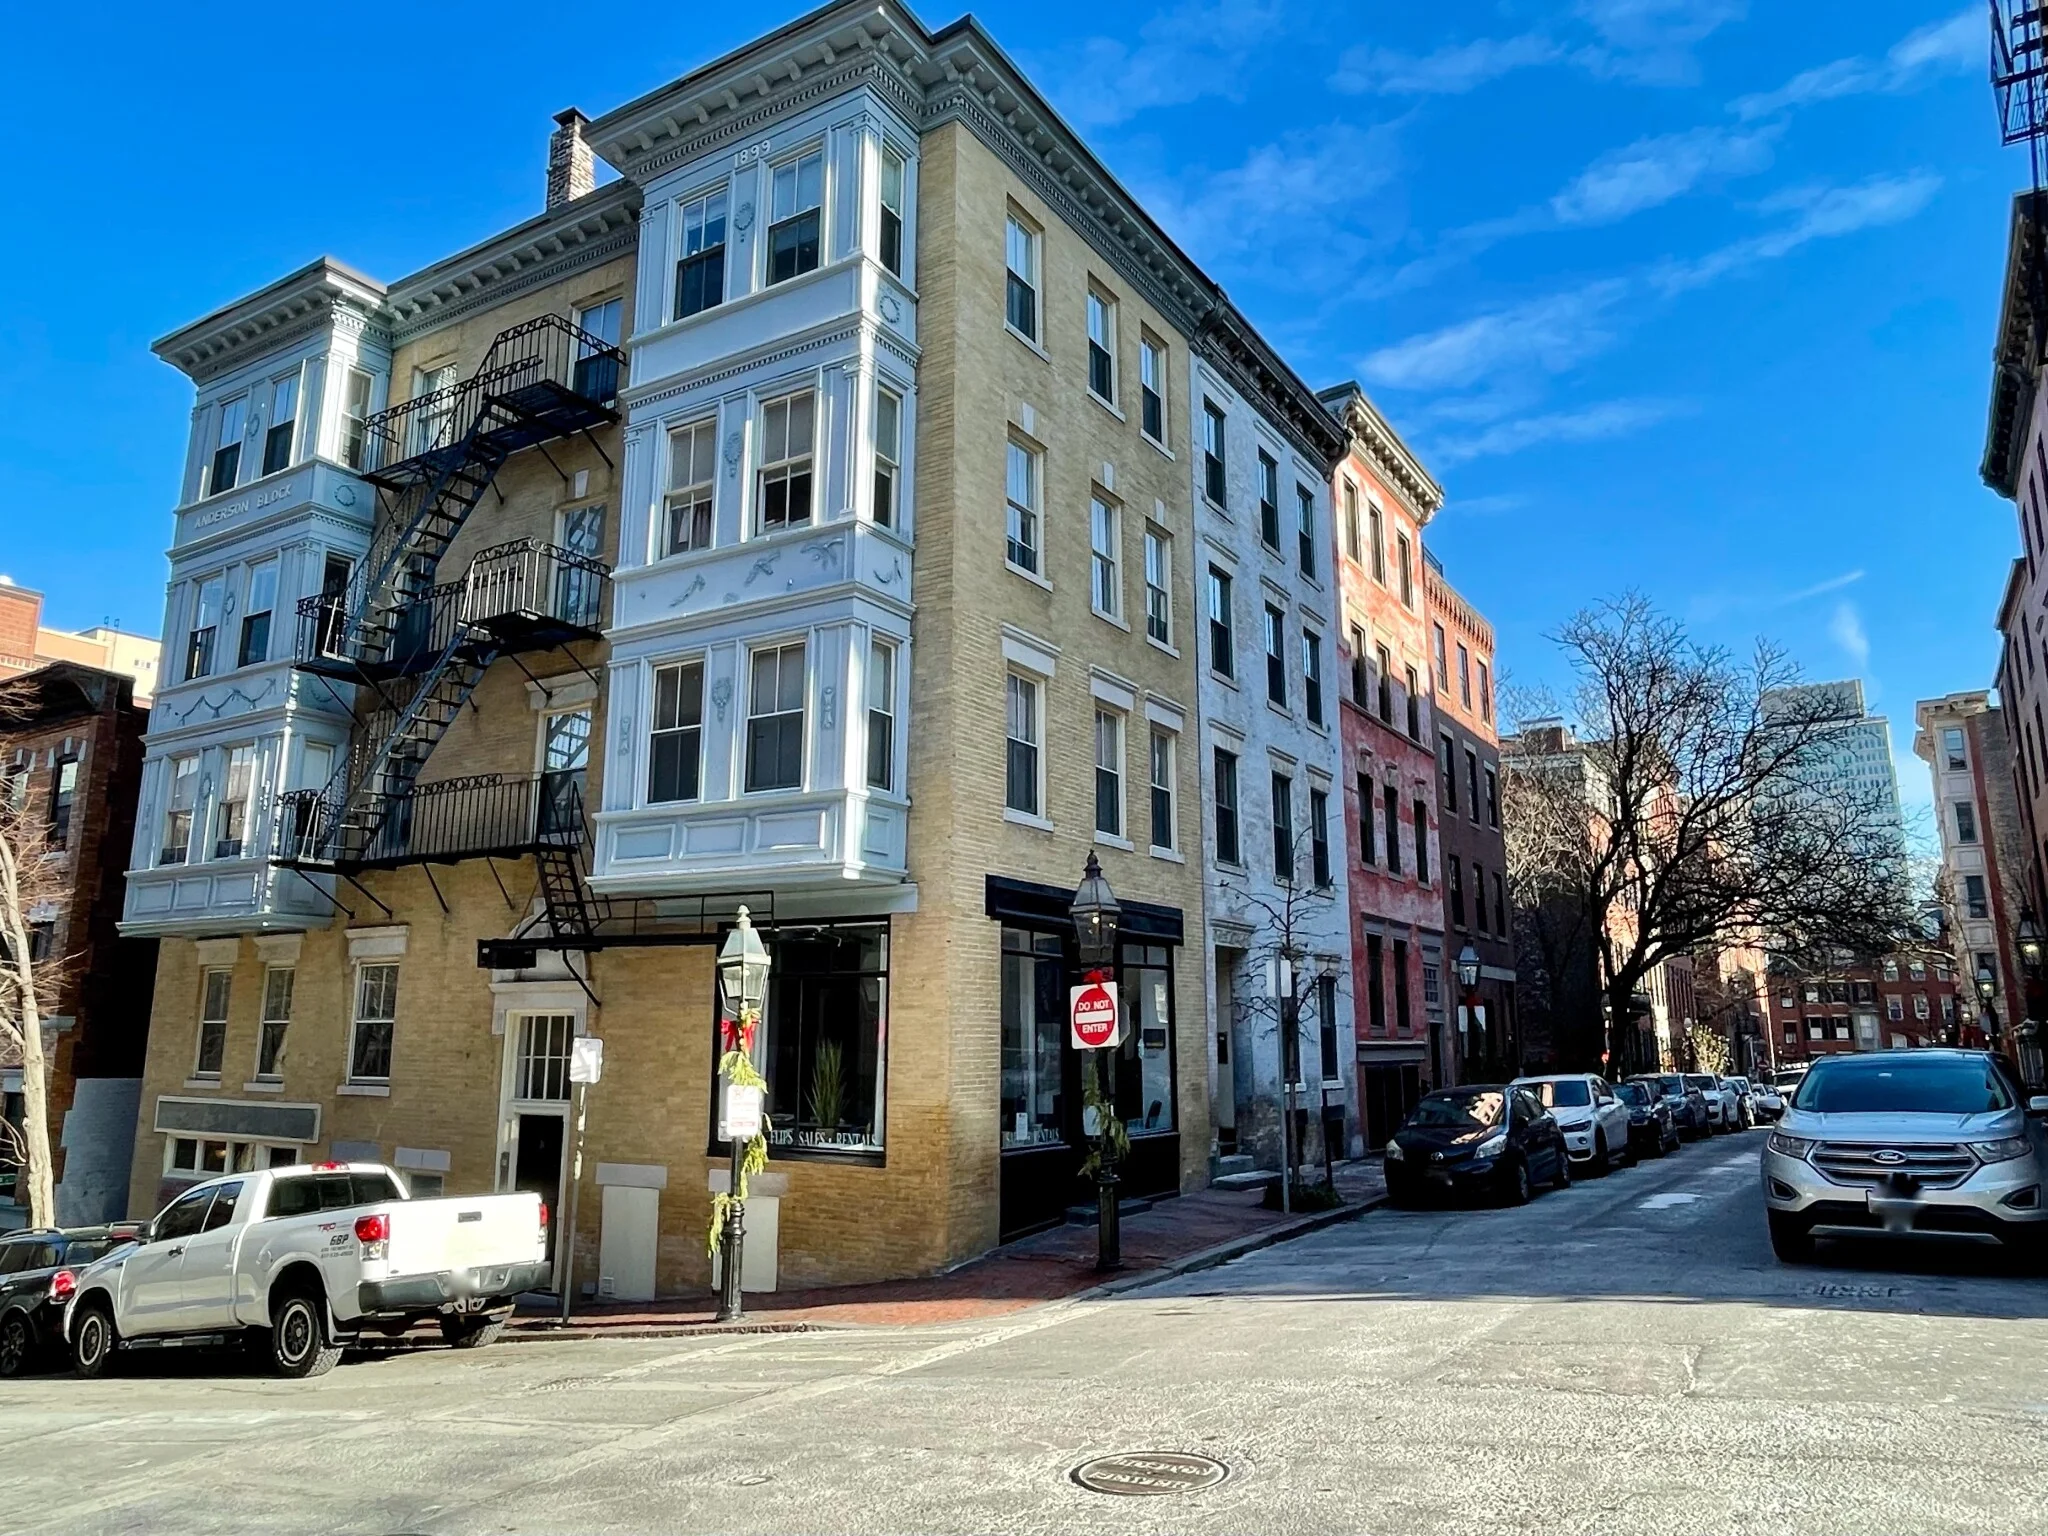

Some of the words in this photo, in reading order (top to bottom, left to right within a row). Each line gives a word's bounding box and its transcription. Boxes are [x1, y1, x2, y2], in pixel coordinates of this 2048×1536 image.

[734, 140, 771, 168] 1899
[194, 500, 249, 529] ANDERSON
[256, 483, 293, 508] BLOCK
[1078, 1001, 1090, 1011] DO
[1093, 1000, 1110, 1010] NOT
[1082, 1023, 1108, 1034] ENTER
[798, 1131, 826, 1147] SALES
[836, 1132, 877, 1146] RENTALS
[1879, 1152, 1899, 1160] Ford
